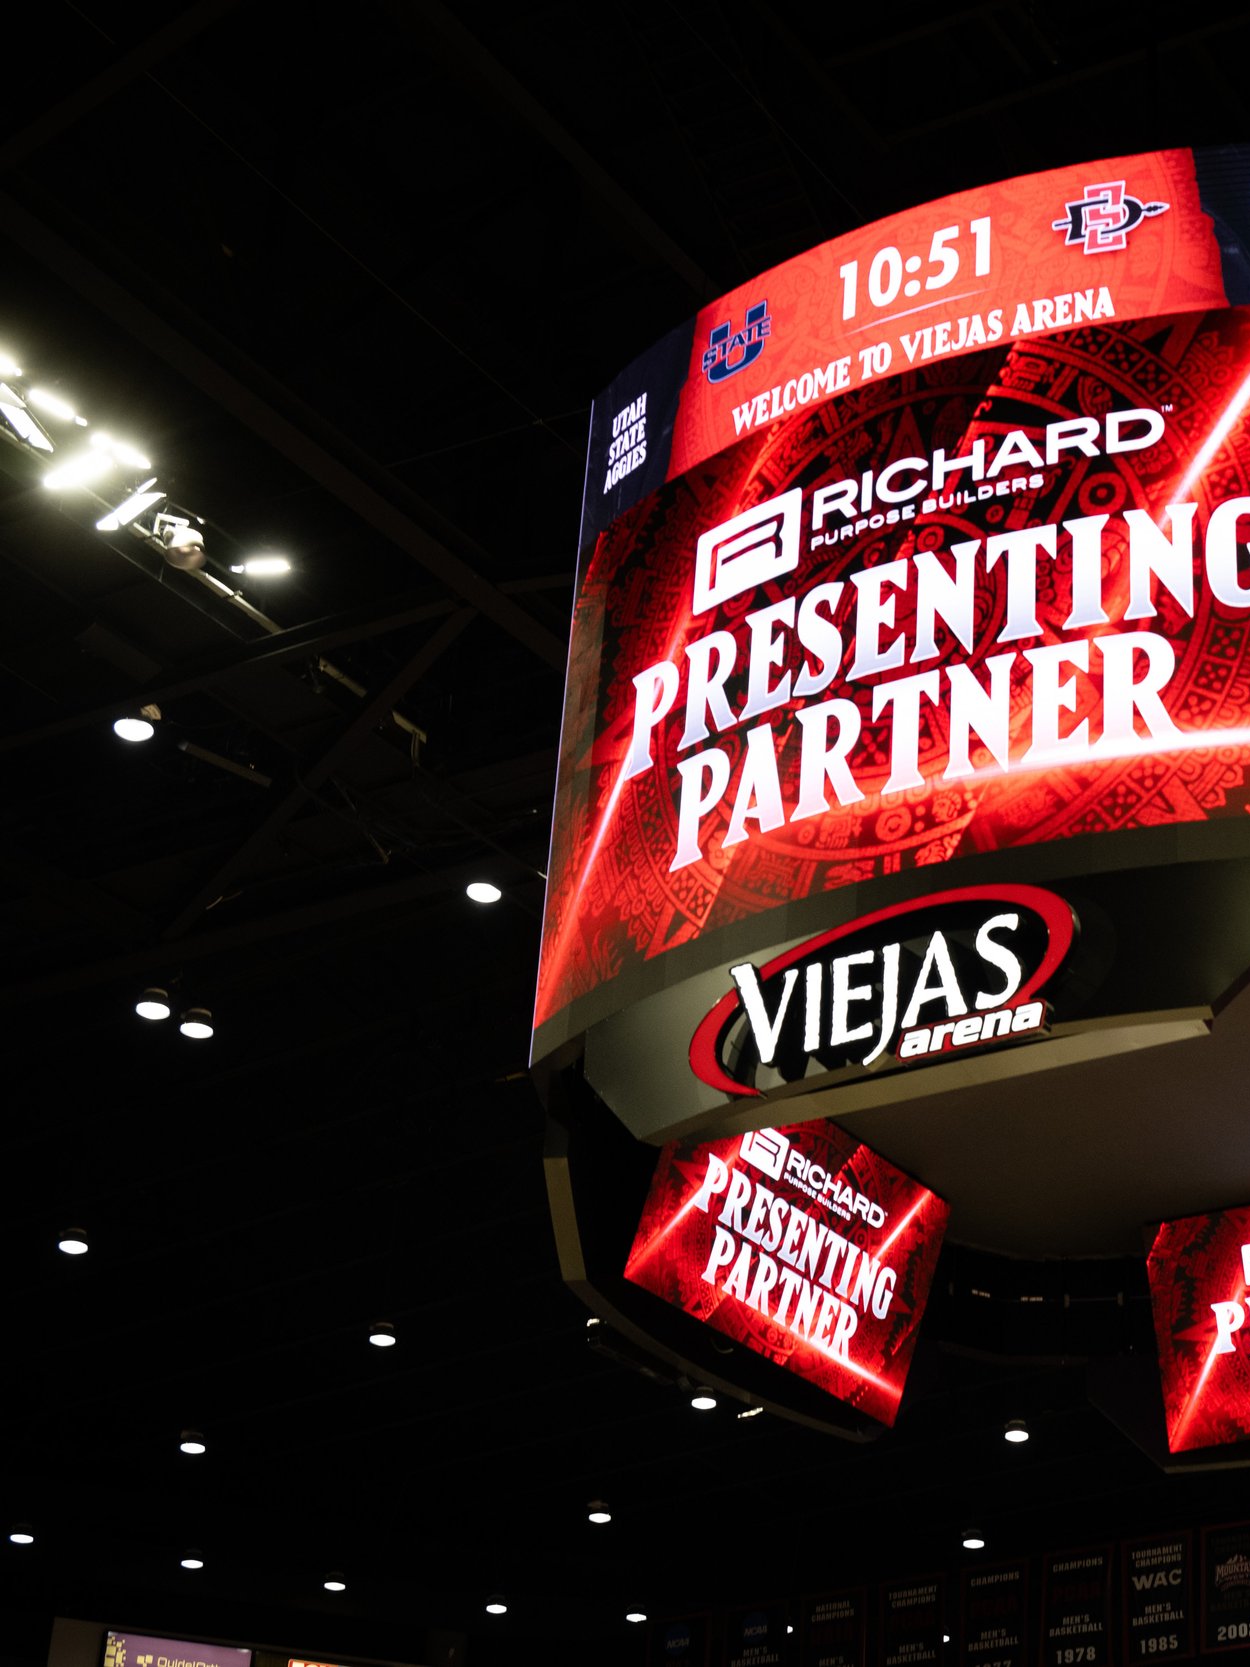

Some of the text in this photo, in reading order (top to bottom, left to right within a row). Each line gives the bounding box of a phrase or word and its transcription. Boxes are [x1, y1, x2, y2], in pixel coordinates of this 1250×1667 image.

[839, 216, 991, 321] 10:51
[731, 286, 1115, 437] WELCOME TO VIEJAS ARENA
[612, 391, 647, 439] UTAH
[608, 418, 647, 466] STATE
[603, 440, 648, 495] AGGIES
[811, 473, 1045, 552] PURPOSE BUILDERS
[669, 630, 1186, 873] PARTNER
[730, 913, 1023, 1067] VIEJAS
[899, 1001, 1044, 1059] arena
[783, 1173, 817, 1201] PURPOSE
[786, 1149, 886, 1229] RICHARD
[694, 1153, 897, 1320] PRESENTING
[701, 1225, 859, 1360] PARTNER
[1131, 1543, 1183, 1560] TOURNAMENT
[1135, 1553, 1182, 1568] CHAMPIONS
[1052, 1556, 1104, 1574] CHAMPIONS
[970, 1570, 1020, 1587] CHAMPIONS
[1131, 1567, 1184, 1592] WAC
[888, 1584, 938, 1601] TOURNAMENT
[891, 1593, 937, 1609] CHAMPIONS
[815, 1600, 851, 1613] NATIONAL
[1144, 1602, 1172, 1615] MEN'S
[811, 1608, 855, 1624] CHAMPIONS
[1062, 1612, 1091, 1626] MEN'S
[1131, 1609, 1185, 1627] BASKETBALL
[743, 1624, 768, 1638] NCAA
[980, 1627, 1007, 1640] MEN'S
[1049, 1621, 1103, 1638] BASKETBALL
[665, 1637, 691, 1650] NCAA
[742, 1646, 768, 1657] MEN'S
[898, 1641, 924, 1654] MEN'S
[968, 1635, 1019, 1653] BASKETBALL
[1139, 1633, 1179, 1656] 1985
[730, 1653, 780, 1667] BASKETBALL
[818, 1655, 844, 1667] MEN'S
[886, 1649, 937, 1667] BASKETBALL
[1055, 1645, 1097, 1666] 1978
